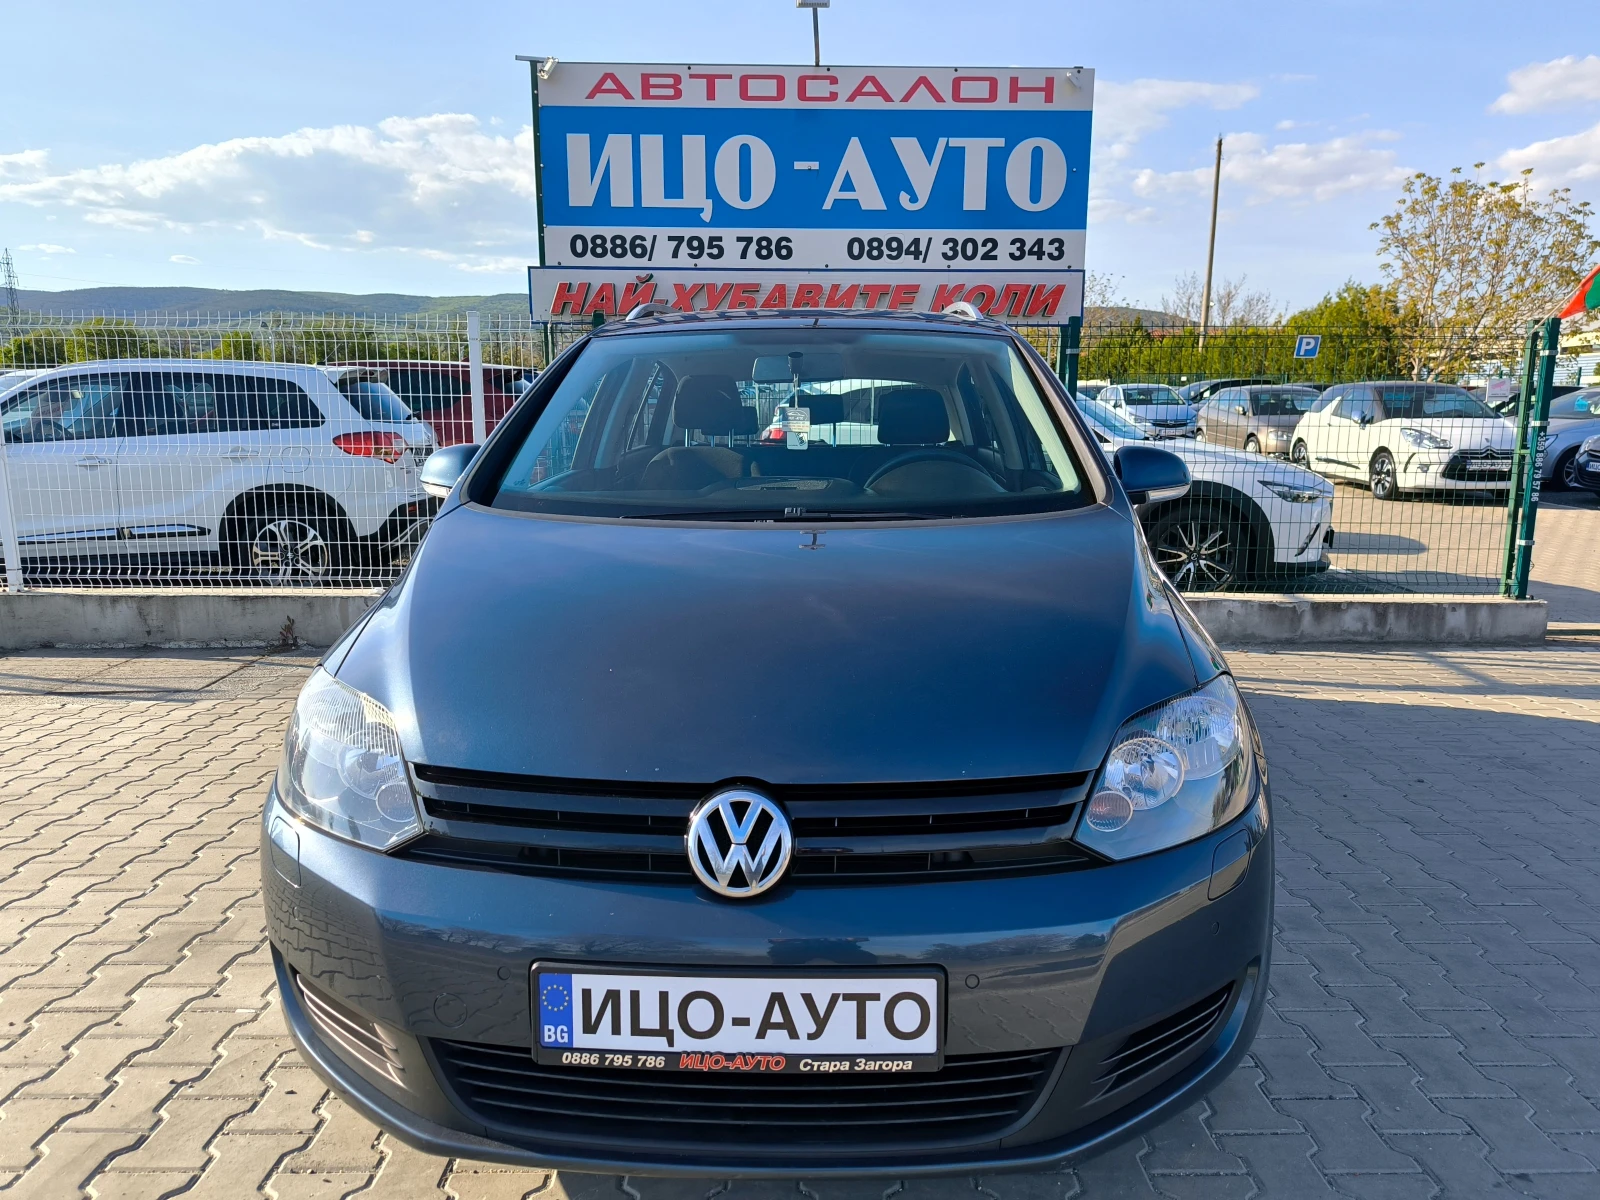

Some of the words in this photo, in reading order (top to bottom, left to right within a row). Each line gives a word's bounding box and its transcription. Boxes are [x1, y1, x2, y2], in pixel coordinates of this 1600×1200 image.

[585, 72, 1055, 104] АВТОСАЛОН
[570, 233, 657, 261] 0886/
[668, 234, 725, 260] 795
[736, 235, 793, 261] 786
[847, 236, 932, 264] 0894/
[941, 237, 998, 262] 302
[1008, 237, 1065, 262] 343
[930, 283, 1068, 317] КОЛИ
[1300, 338, 1315, 355] P
[1537, 431, 1546, 451] +359
[1534, 453, 1544, 467] 886
[1533, 469, 1543, 479] 79
[1532, 481, 1541, 490] 57
[1531, 493, 1540, 502] 86
[581, 988, 931, 1048] ИЦО-АУТО
[543, 1025, 569, 1044] BG
[561, 1052, 600, 1066] 0886
[604, 1053, 633, 1067] 795
[636, 1055, 666, 1069] 786
[679, 1052, 786, 1071] ИЦО-АУТО
[799, 1058, 852, 1073] Стара
[854, 1058, 913, 1073] Загора
